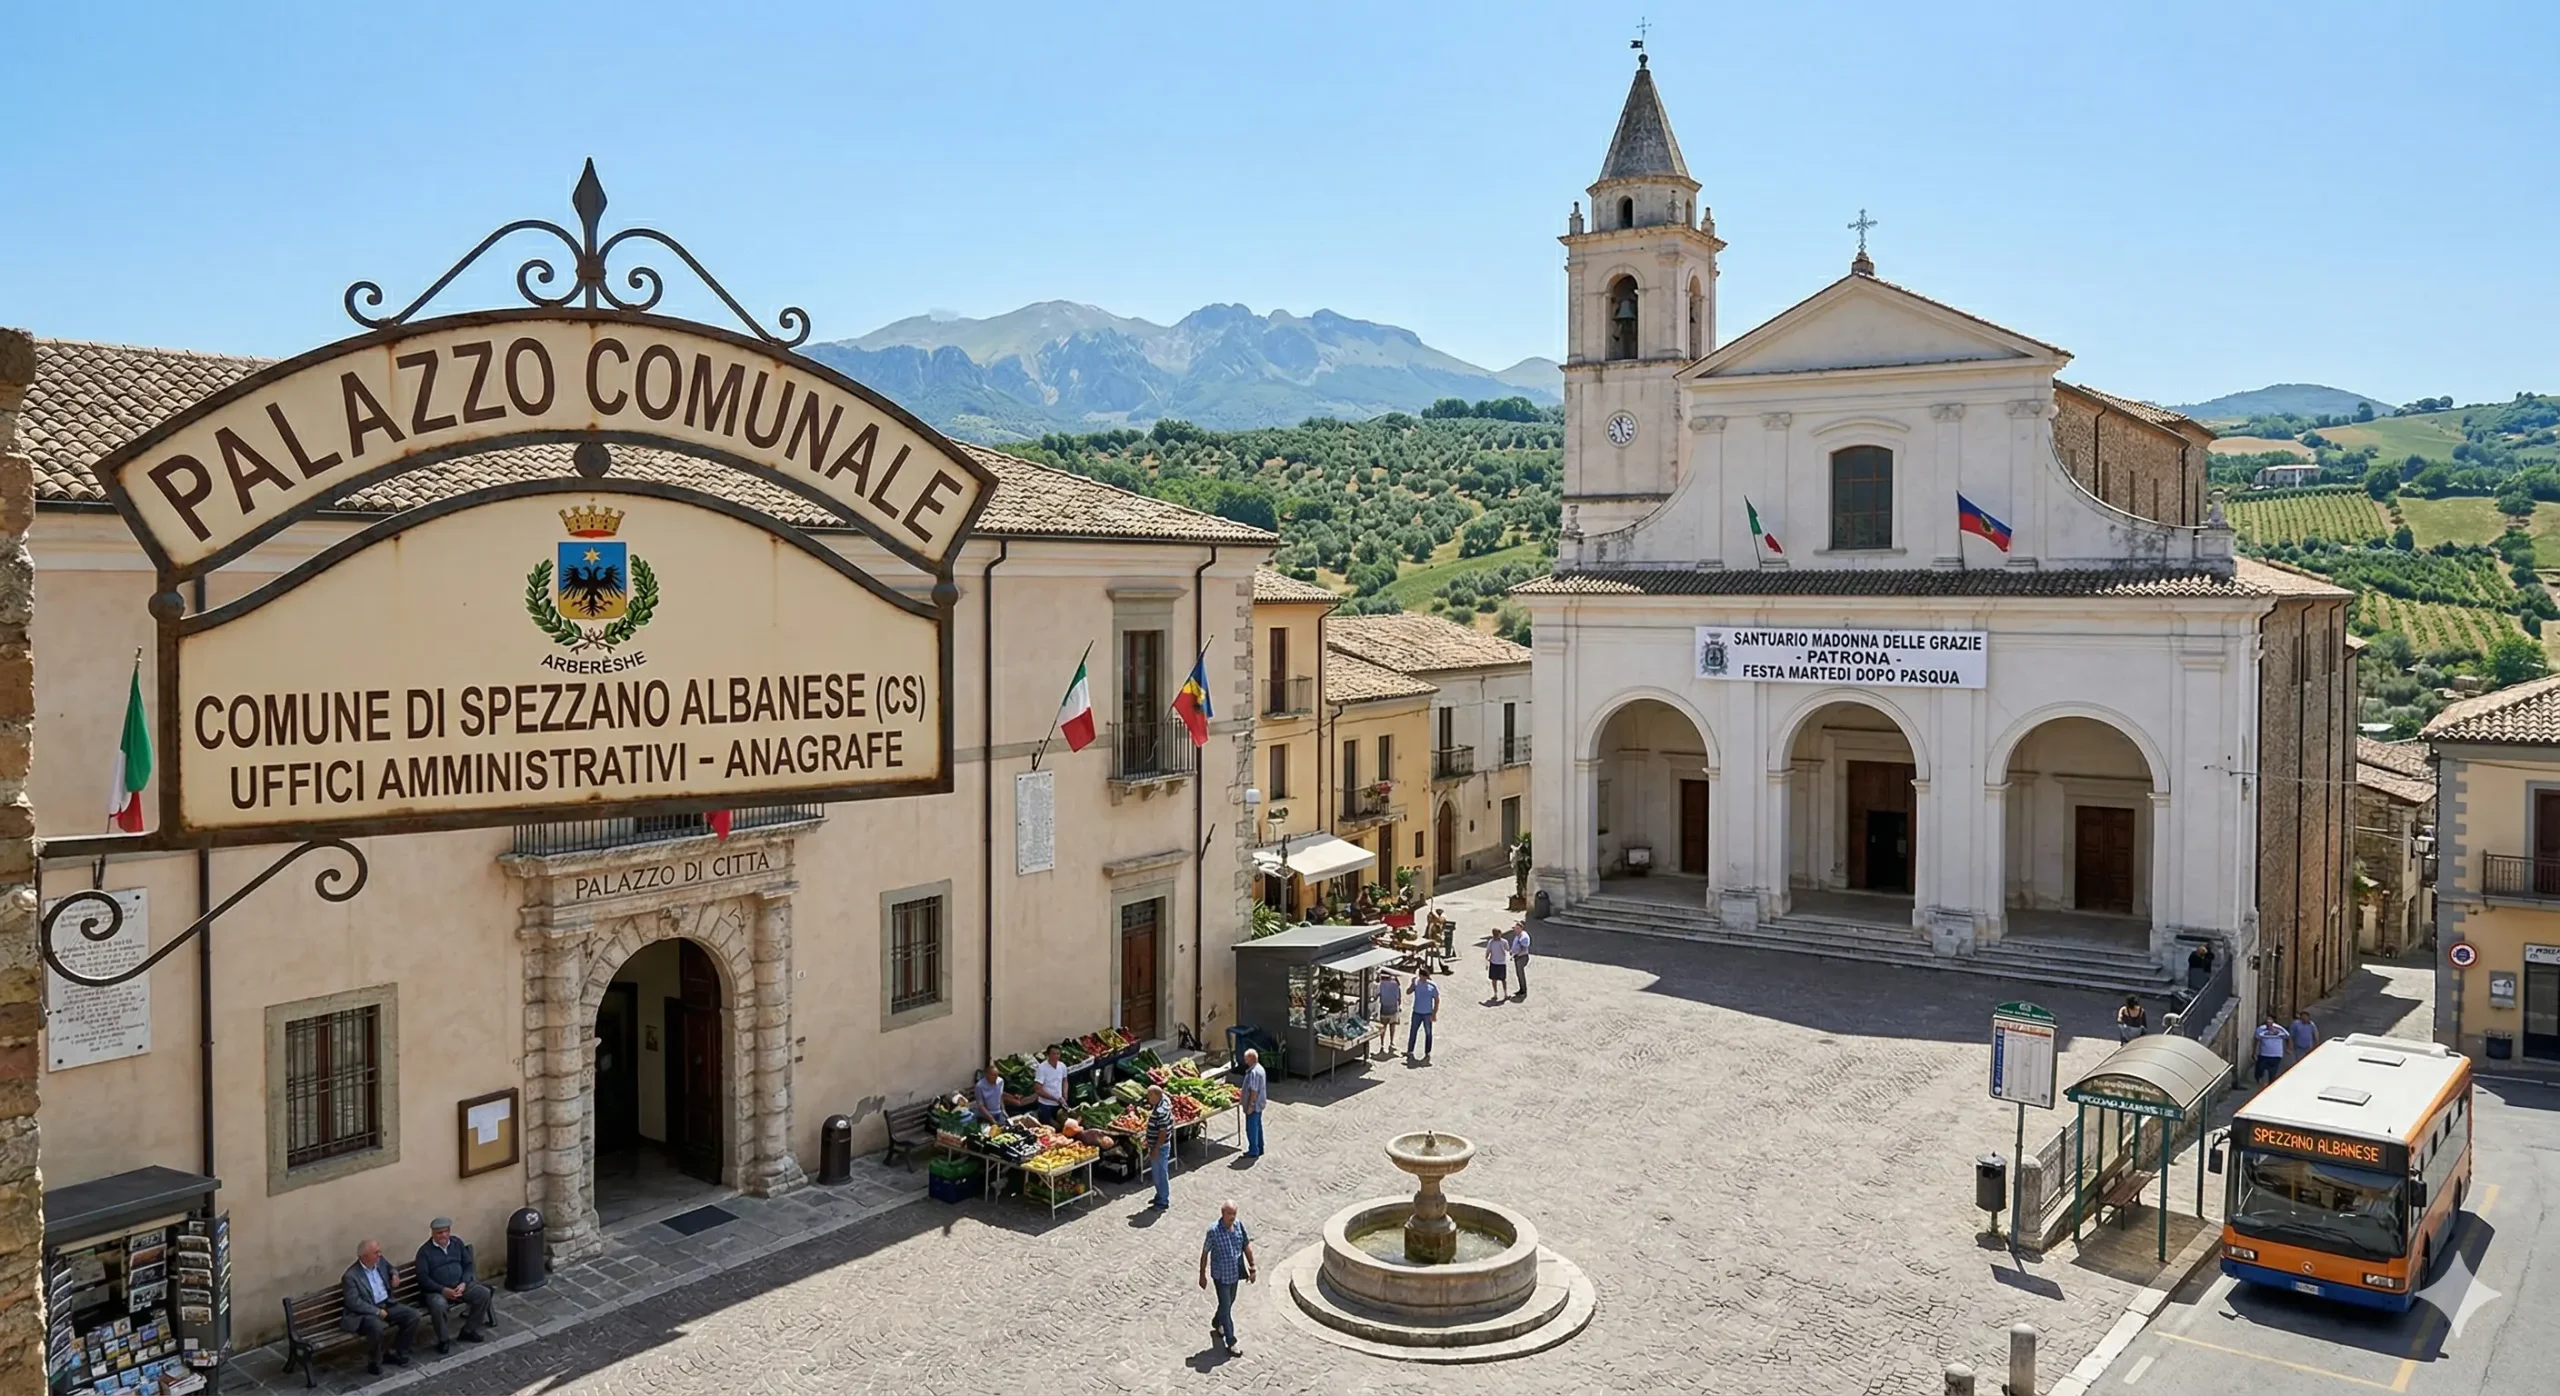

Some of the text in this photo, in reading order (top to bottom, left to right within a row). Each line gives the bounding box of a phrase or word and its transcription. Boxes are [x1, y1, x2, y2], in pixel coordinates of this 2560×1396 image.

[146, 337, 964, 544] PALAZZO COMUNALE
[1733, 631, 1982, 651] SANTUARIO MADONNA DELLE GRAZIE
[1807, 650, 1891, 666] PATRONA
[1743, 664, 1960, 685] FESTA MARTEDI DOPO PASQUA
[195, 672, 927, 750] COMUNE DI SPEZZANO ALBANESE (CS)
[230, 760, 365, 810] UFFICI
[376, 742, 687, 800] AMMINISTRATIVI
[724, 730, 903, 779] ANAGRAFE
[575, 865, 676, 900] PALAZZO
[684, 860, 702, 882] DI
[2254, 1127, 2380, 1162] SPEZZANO ALBANESE
